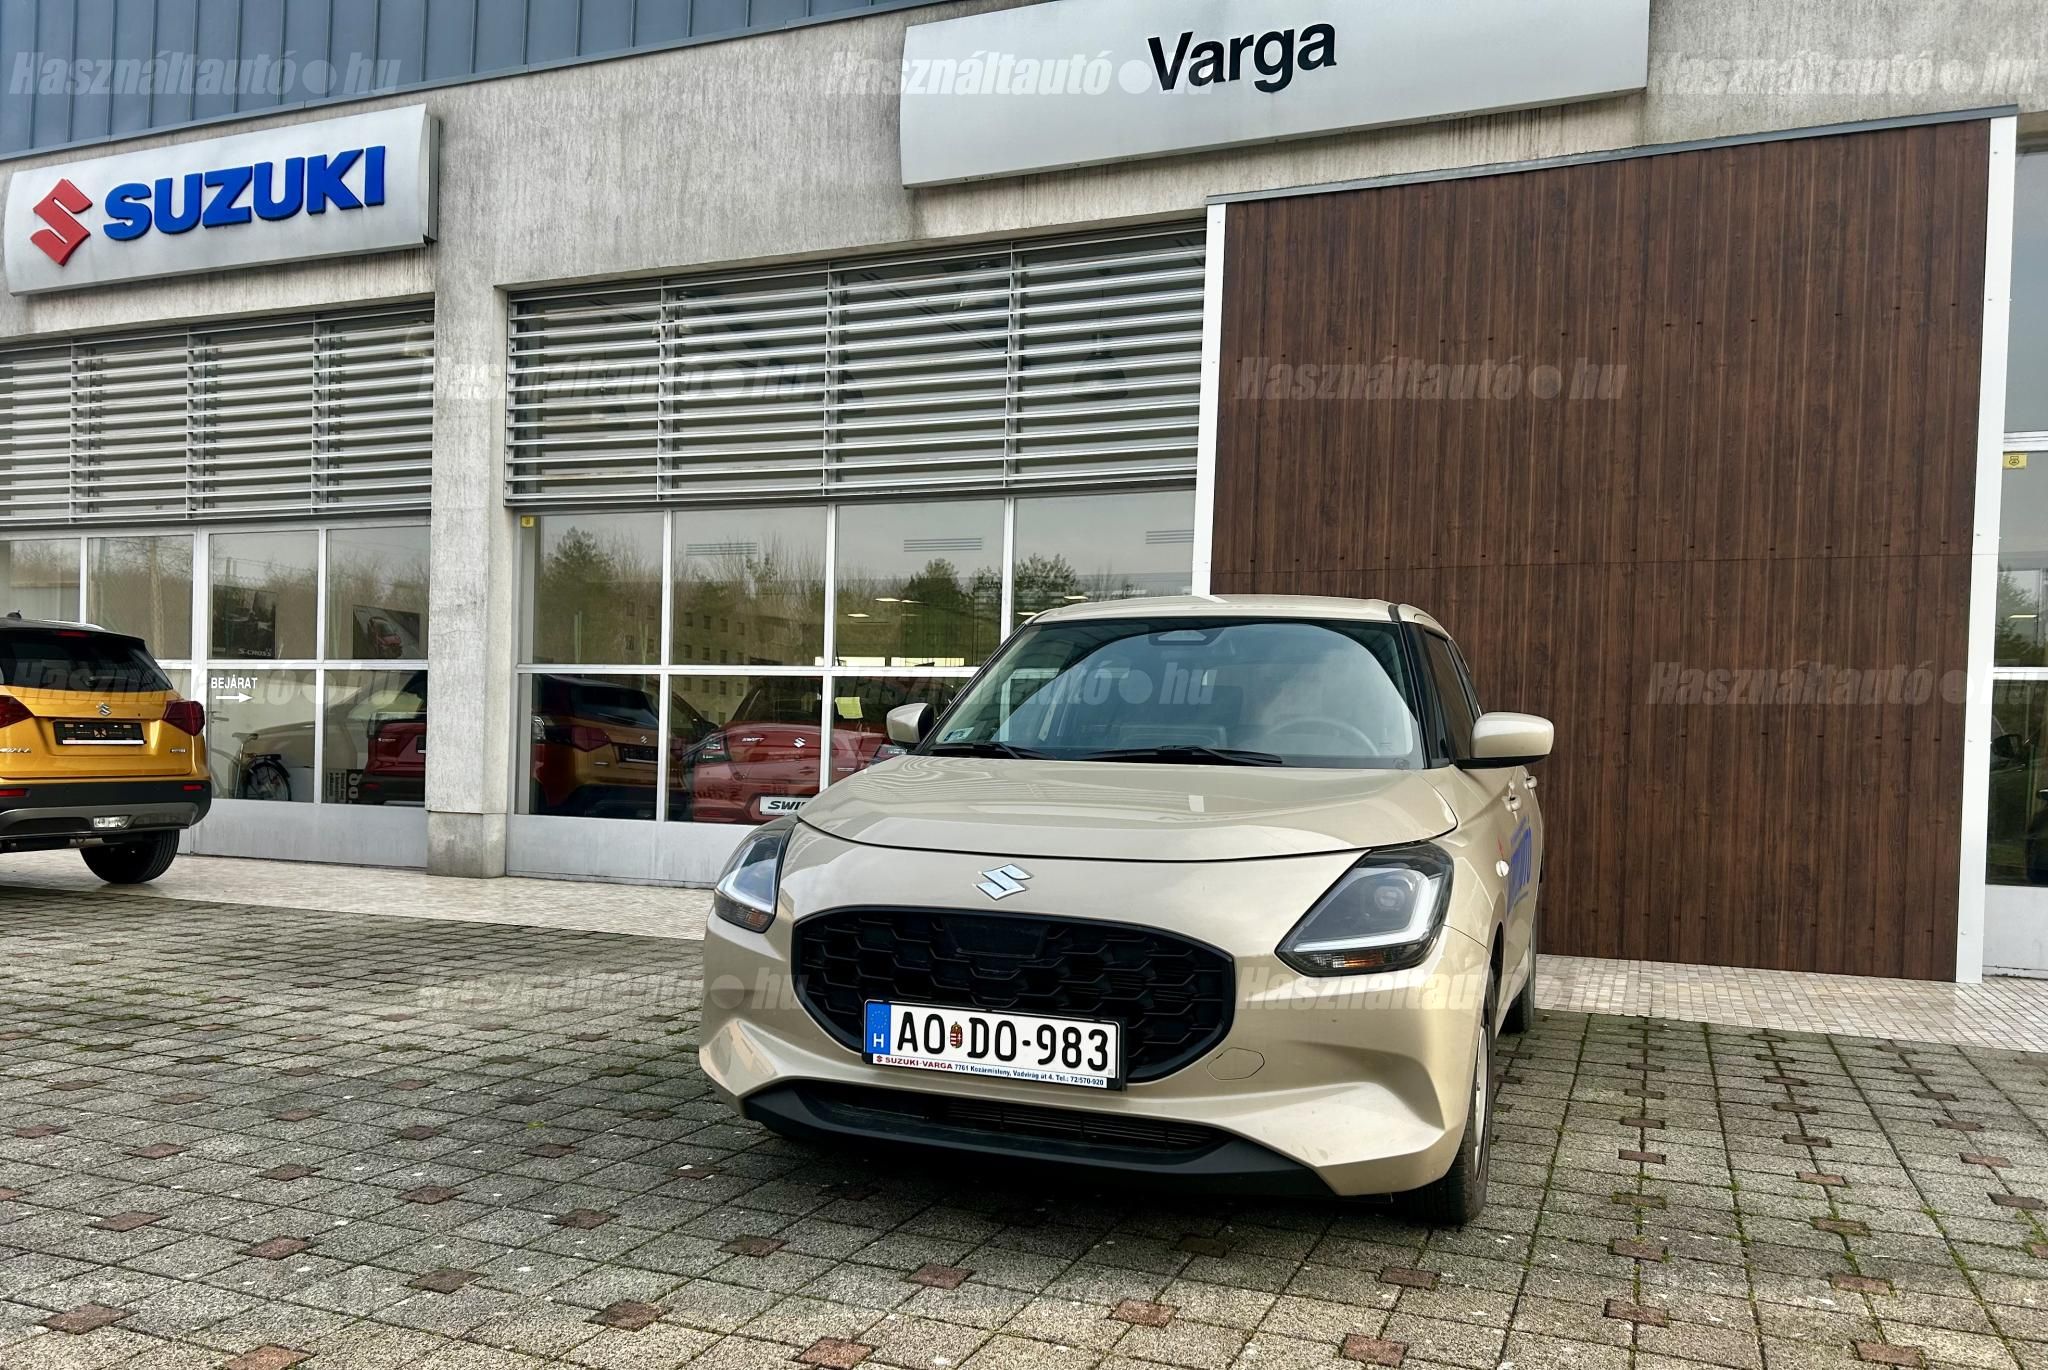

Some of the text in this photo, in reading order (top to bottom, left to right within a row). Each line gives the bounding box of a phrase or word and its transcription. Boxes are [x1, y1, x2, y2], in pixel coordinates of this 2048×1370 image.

[1148, 23, 1337, 93] Varga
[103, 145, 386, 241] SUZUKI
[210, 674, 258, 689] BEJÁRAT
[873, 1033, 884, 1048] H
[897, 1011, 1108, 1071] AO DO-983
[885, 1057, 953, 1070] SUZUKI-VARGA
